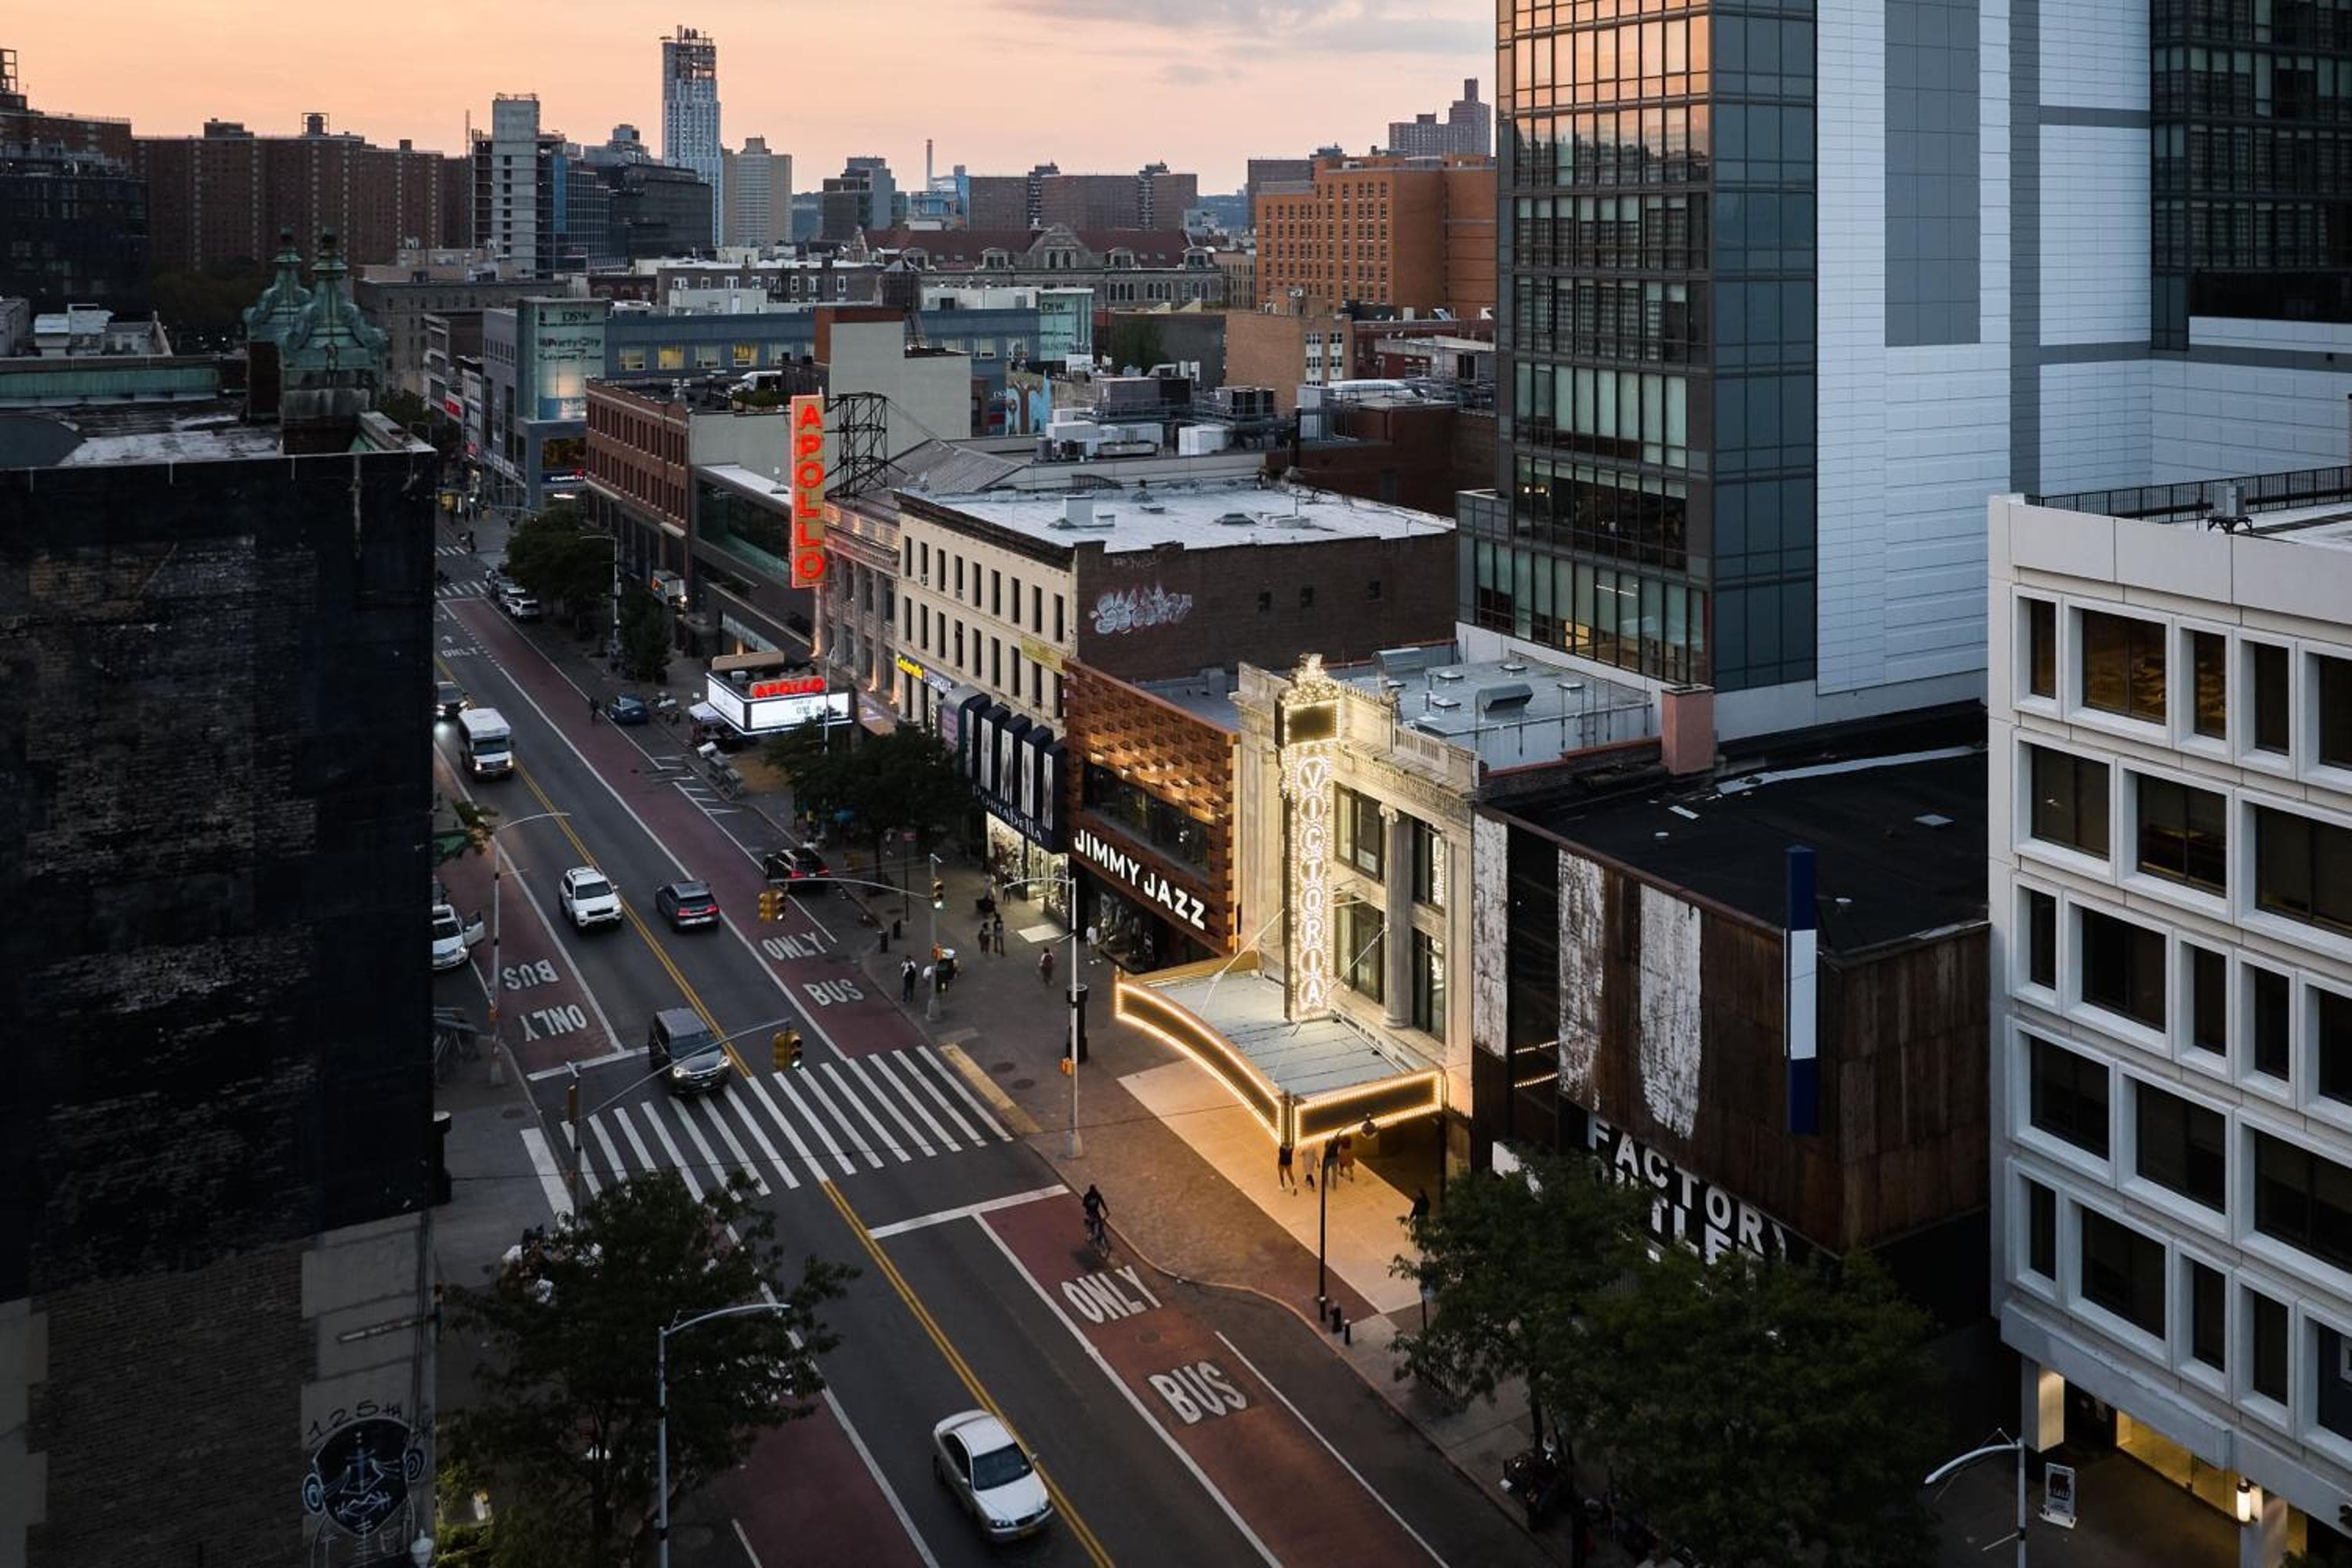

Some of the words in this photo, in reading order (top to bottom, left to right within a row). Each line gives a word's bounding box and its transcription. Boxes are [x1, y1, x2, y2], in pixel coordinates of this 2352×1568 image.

[798, 404, 826, 579] APOLLO
[753, 677, 826, 698] APOLLO
[1074, 829, 1141, 887] JIMMY
[1144, 873, 1205, 931] JAZZ
[1302, 762, 1323, 1006] VICTORIA
[762, 931, 827, 960] ONLY
[503, 959, 560, 989] BUS
[803, 978, 864, 1006] BUS
[519, 1004, 587, 1042] ONLY
[1061, 1265, 1162, 1323] ONLY
[1149, 1361, 1247, 1425] BUS
